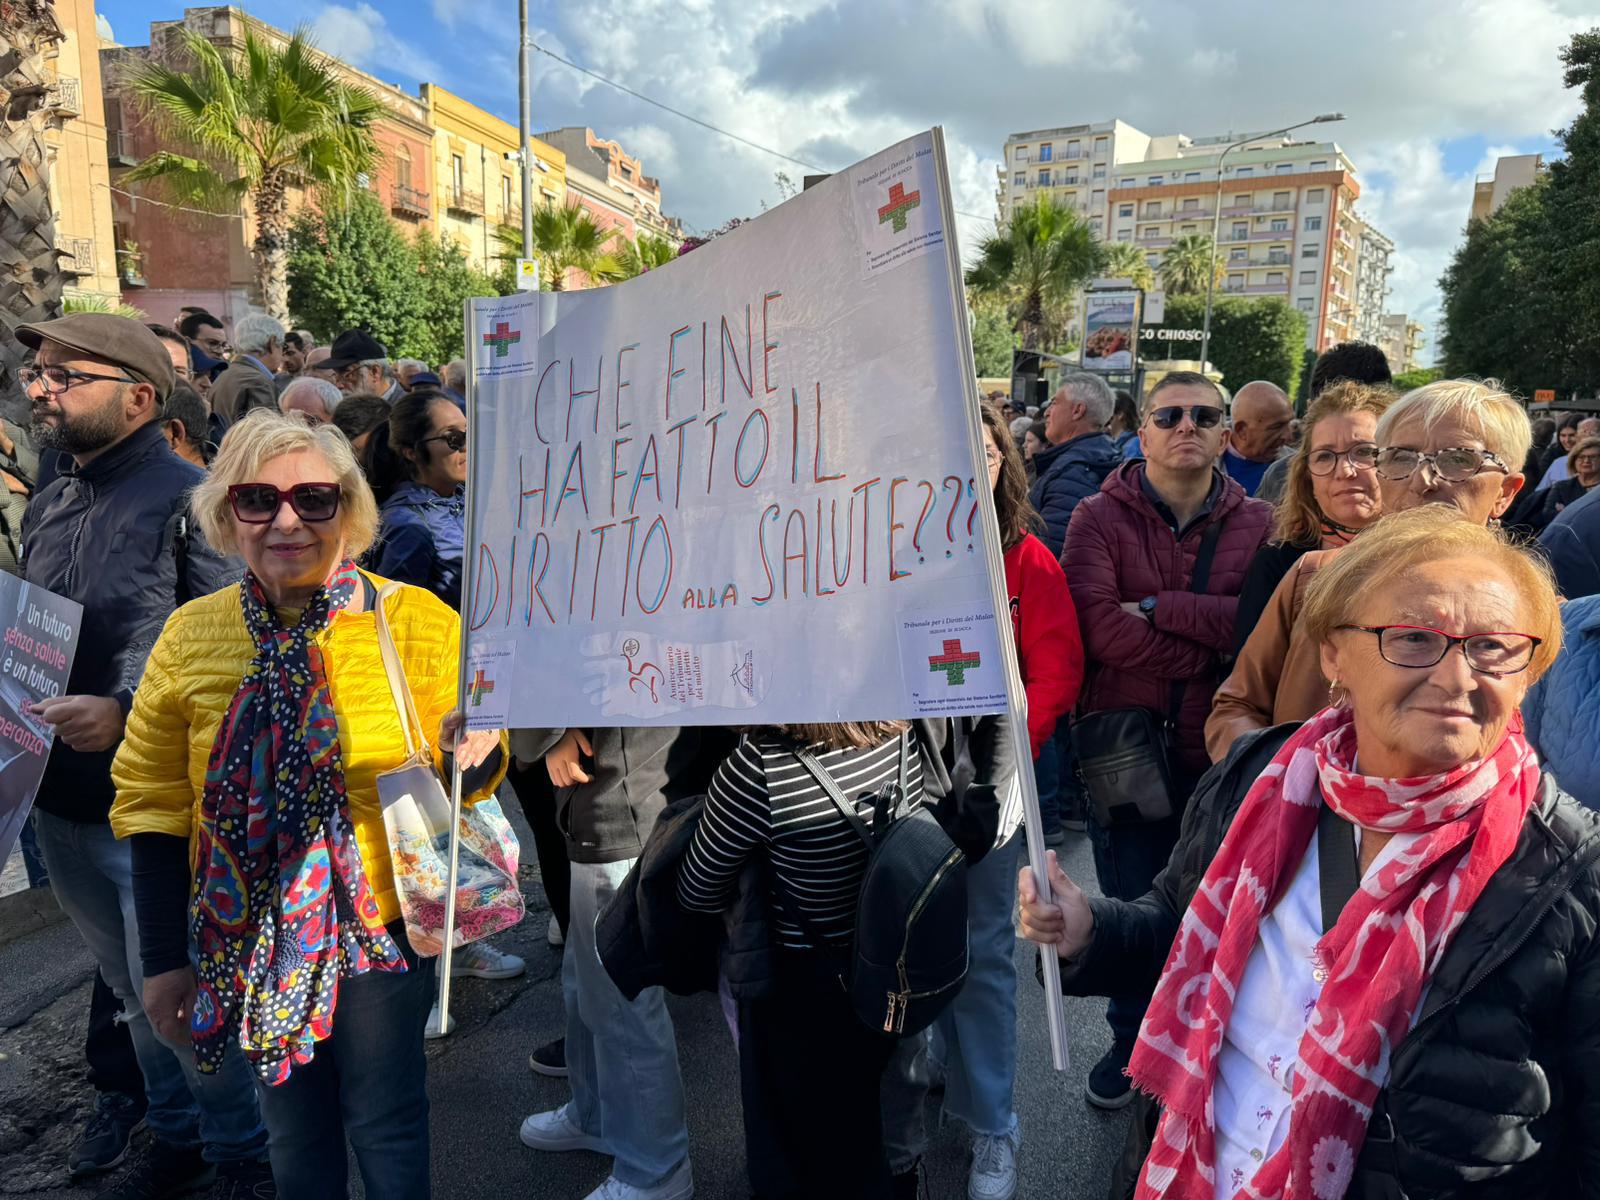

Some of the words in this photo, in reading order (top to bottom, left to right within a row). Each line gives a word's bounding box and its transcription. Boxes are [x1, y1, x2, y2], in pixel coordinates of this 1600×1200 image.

[1157, 328, 1211, 341] CHIOSCO
[535, 342, 640, 444] CHE
[666, 290, 782, 420] FINE
[518, 441, 589, 529] HA
[611, 408, 769, 518] FATTO
[791, 382, 846, 484] IL
[470, 514, 673, 631] DIRITTO
[682, 583, 738, 609] ALLA
[27, 602, 41, 626] Un
[41, 609, 72, 642] futuro
[904, 620, 930, 629] Tribunale
[931, 619, 941, 627] per
[4, 626, 34, 654] senza
[35, 638, 66, 671] salute
[674, 648, 685, 689] Tribunale
[683, 651, 691, 675] diritti
[693, 655, 702, 685] malato
[3, 650, 14, 673] è
[13, 660, 27, 682] un
[27, 664, 59, 698] futuro
[620, 653, 665, 703] 25
[666, 646, 677, 700] Anniversario
[687, 682, 696, 696] per
